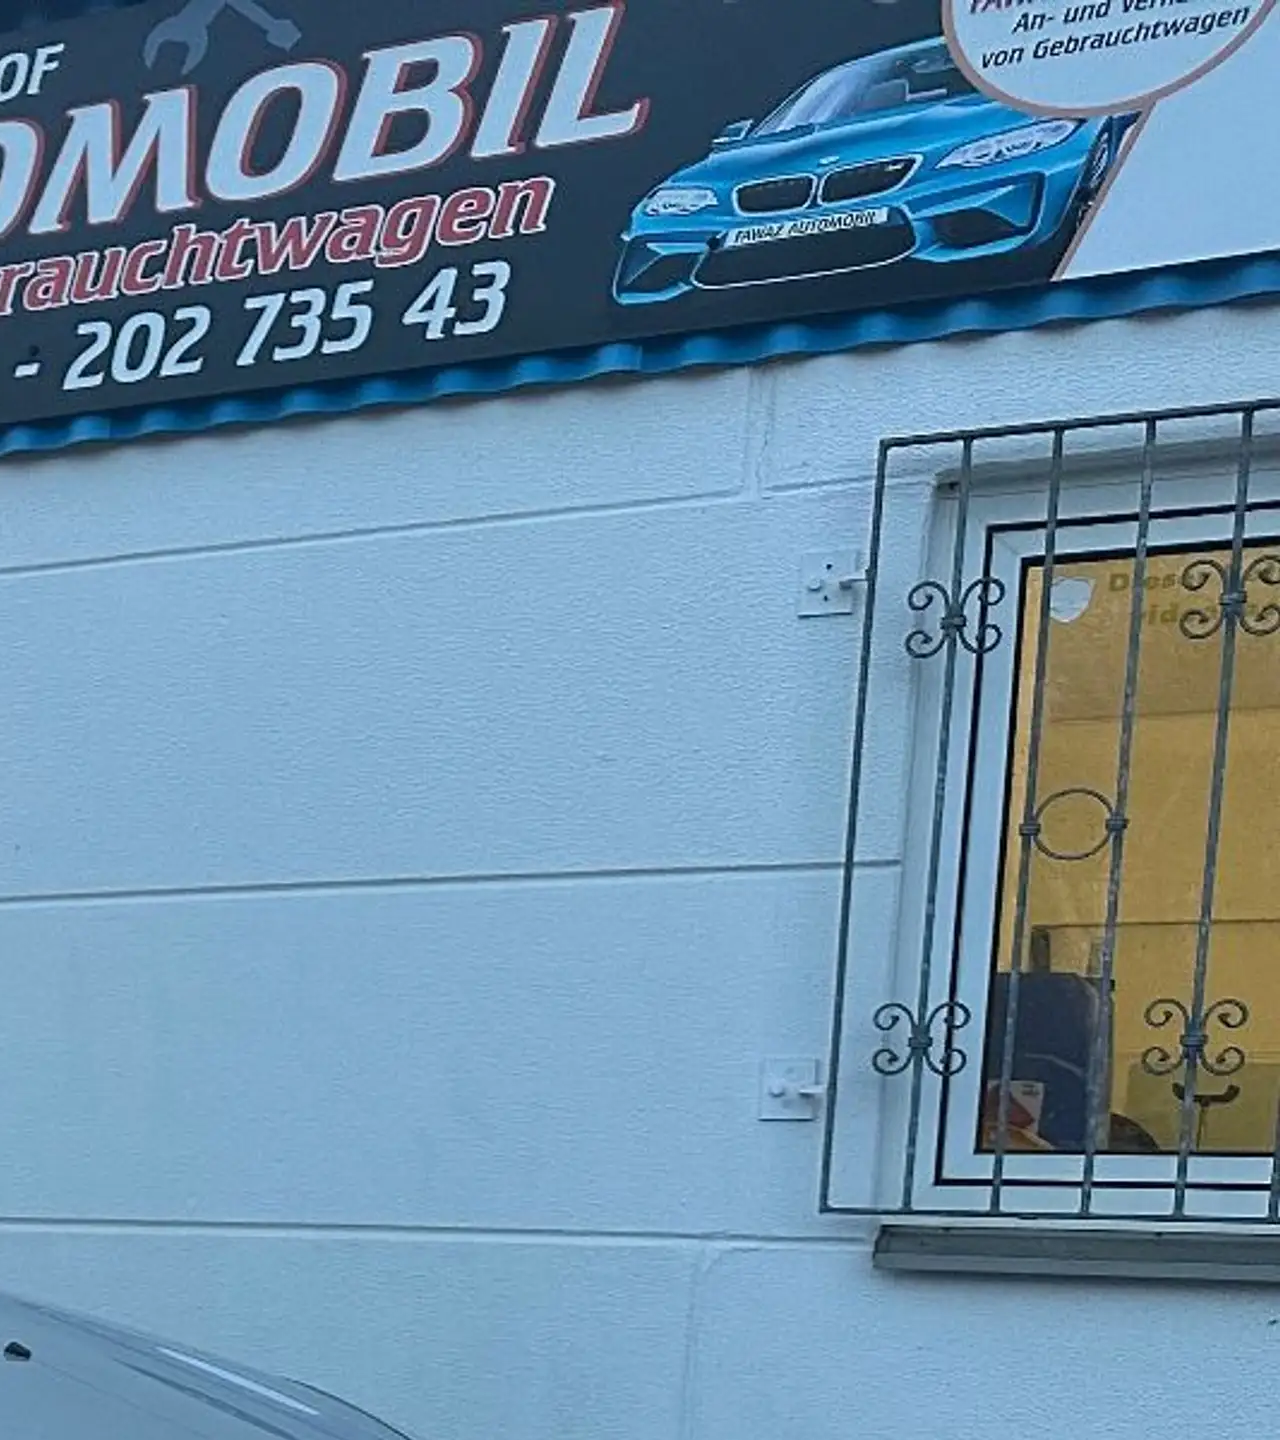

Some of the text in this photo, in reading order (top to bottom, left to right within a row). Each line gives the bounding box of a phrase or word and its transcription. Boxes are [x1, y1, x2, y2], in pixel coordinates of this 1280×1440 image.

[981, 6, 1251, 69] von Gebrauchtwagen
[1011, 11, 1054, 35] An-
[1062, 2, 1110, 24] und
[62, 305, 212, 392] 202
[237, 279, 373, 366] 735
[402, 260, 510, 341] 43
